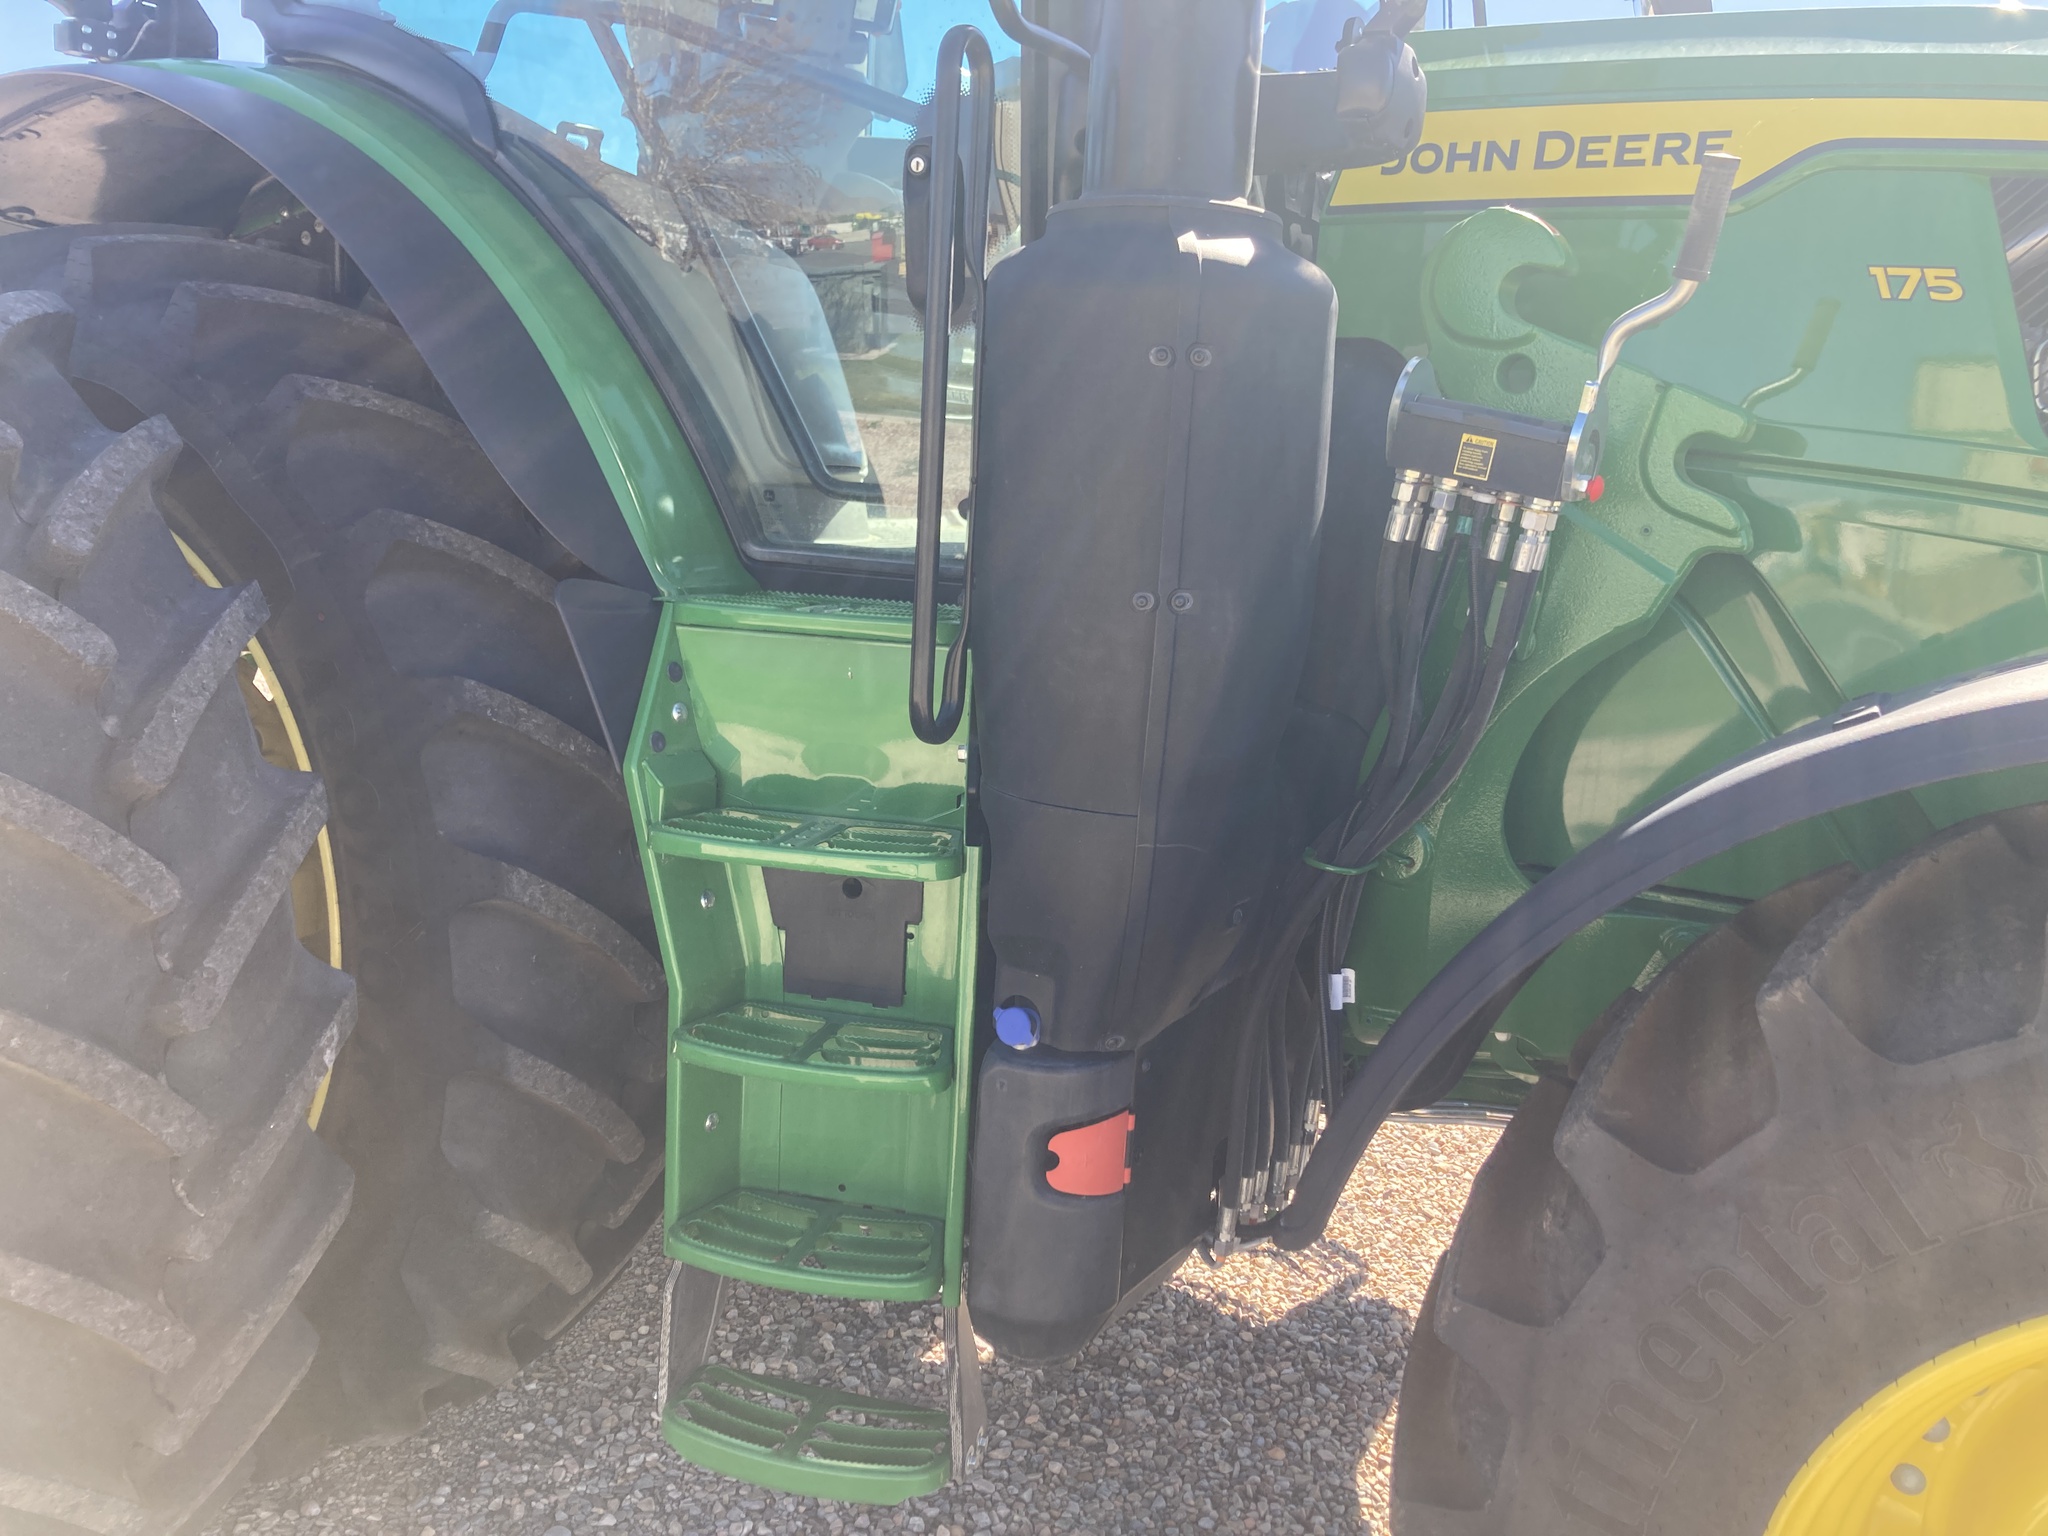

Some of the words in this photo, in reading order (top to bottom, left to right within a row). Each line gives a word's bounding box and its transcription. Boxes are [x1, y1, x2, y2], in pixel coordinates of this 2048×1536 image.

[1380, 139, 1521, 176] JOHN
[1533, 129, 1733, 171] DEERE
[1866, 264, 1964, 302] 175
